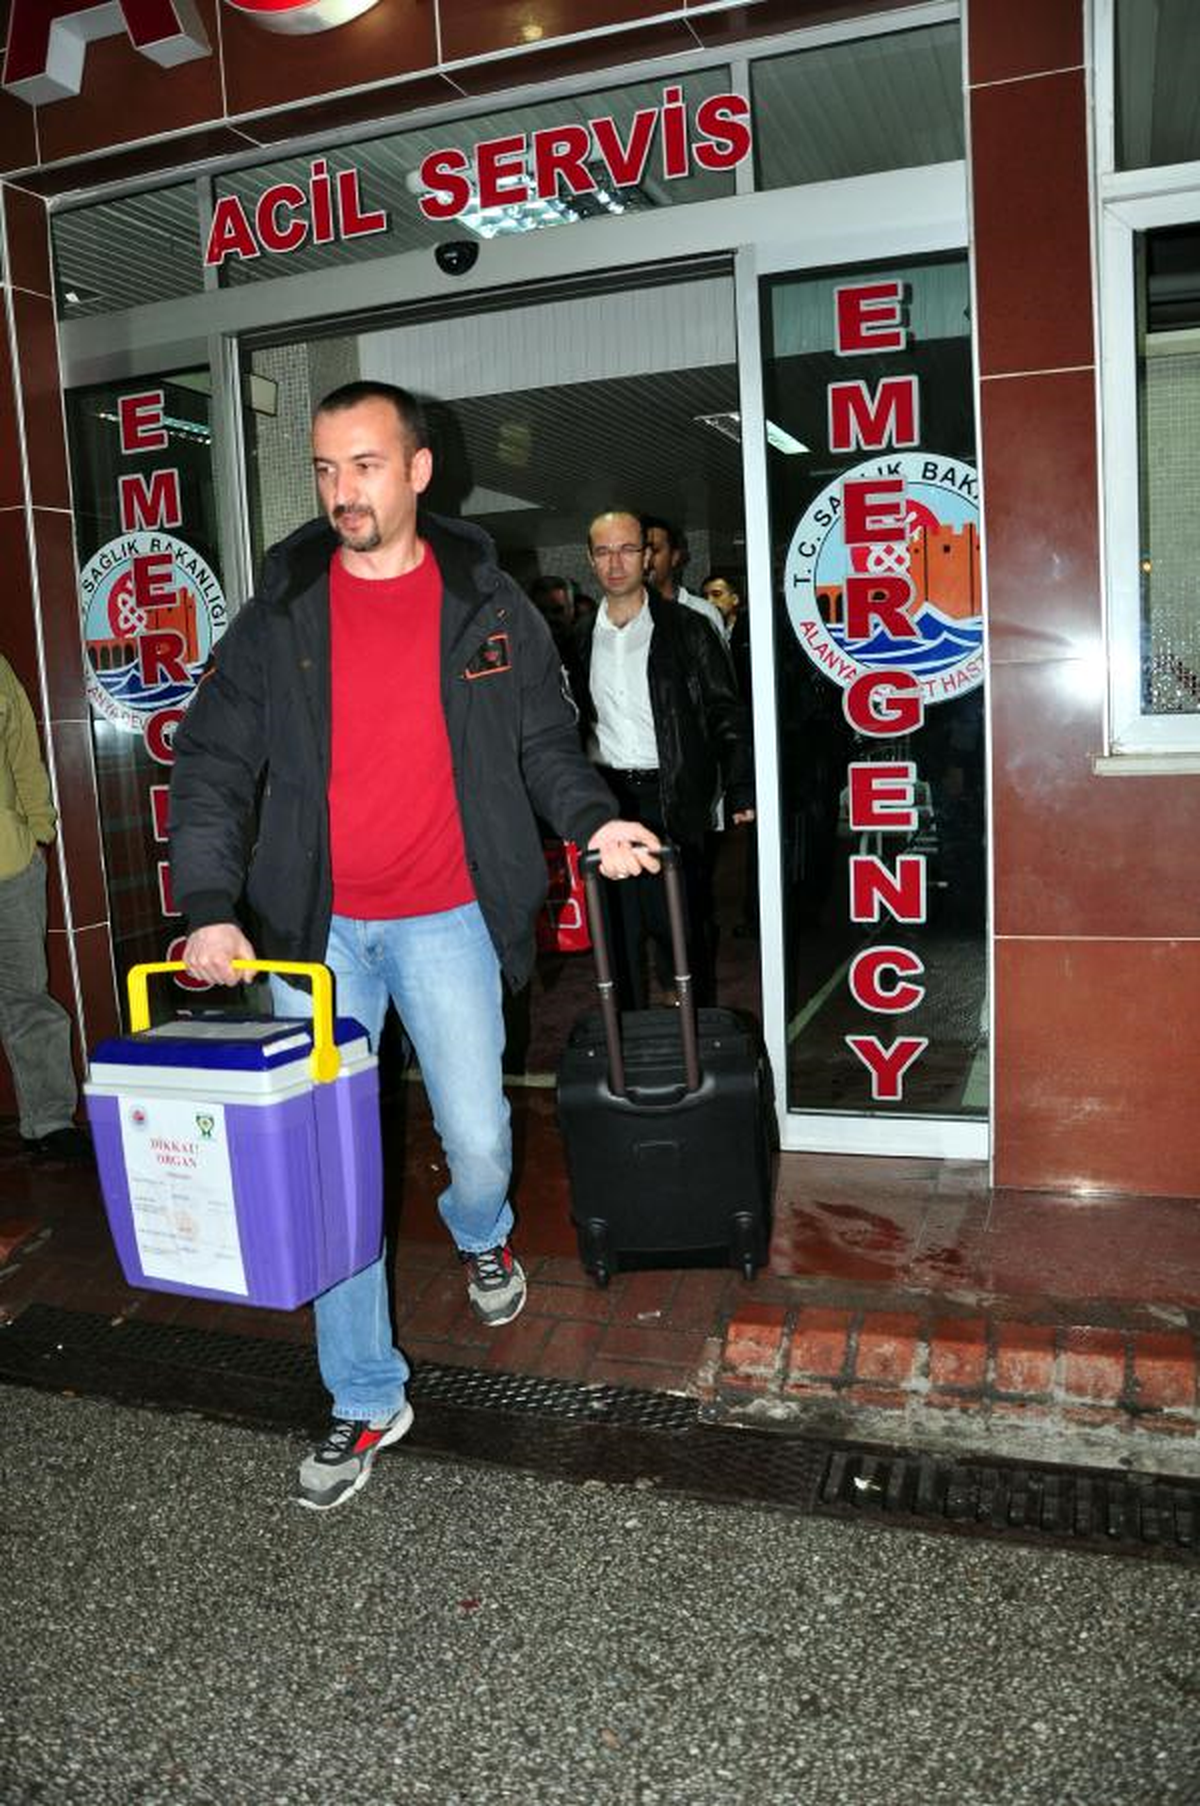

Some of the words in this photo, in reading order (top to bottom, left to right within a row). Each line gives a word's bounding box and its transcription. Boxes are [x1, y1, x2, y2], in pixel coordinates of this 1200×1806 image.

[204, 159, 388, 267] ACİL
[418, 86, 753, 222] SERVİS
[921, 461, 979, 500] BAK
[828, 279, 928, 1100] EMERGENCY
